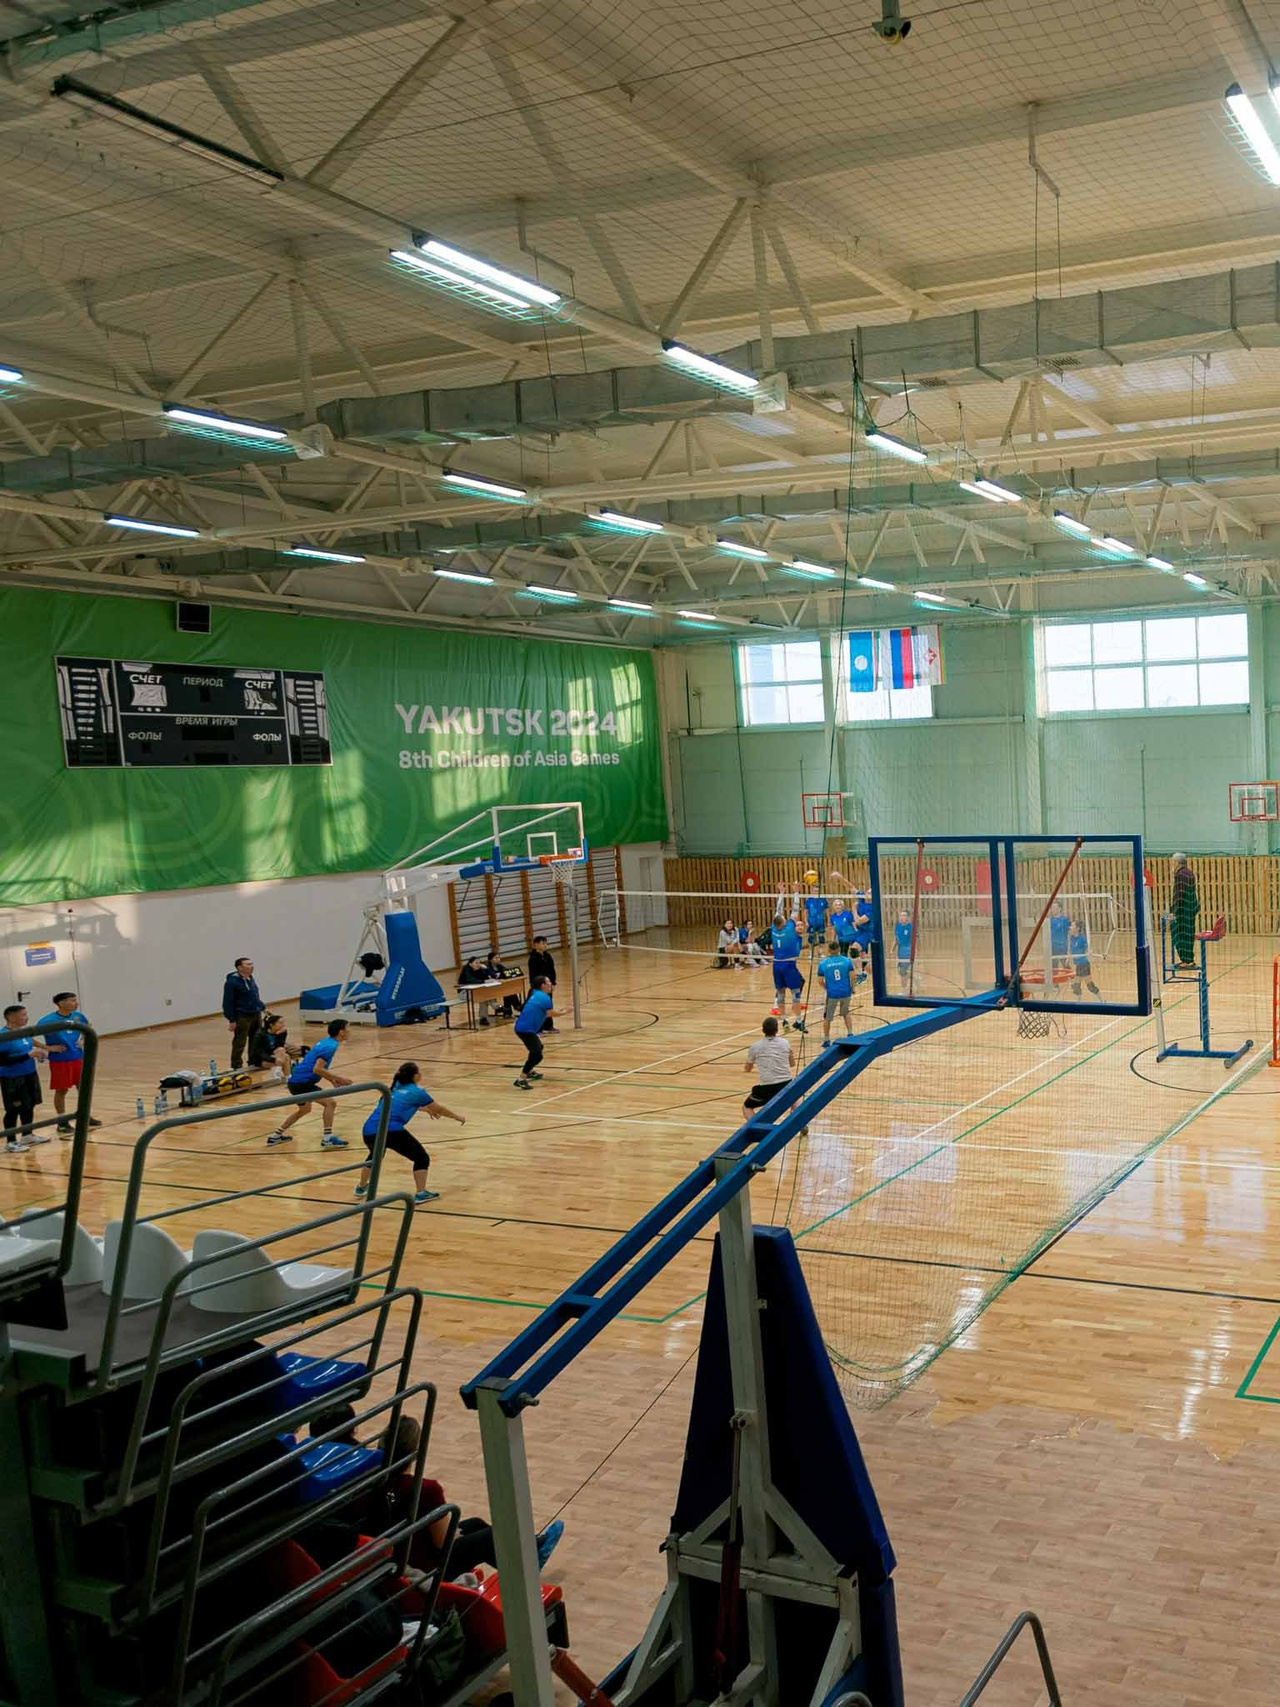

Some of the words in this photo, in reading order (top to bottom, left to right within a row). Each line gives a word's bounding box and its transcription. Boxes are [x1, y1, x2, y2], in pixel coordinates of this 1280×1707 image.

[130, 674, 163, 684] СЧЕТ
[183, 677, 223, 687] ПЕРИОД
[245, 680, 273, 689] СЧЕТ
[175, 716, 208, 725] ВРЕМЯ
[212, 717, 238, 726] ИГРЫ
[394, 703, 544, 735] YAKUTSK
[551, 709, 617, 736] 2024
[128, 731, 162, 741] ФОЛЫ
[252, 732, 281, 741] ФОЛЫ
[399, 751, 433, 768] 8th
[437, 750, 510, 768] Children
[513, 751, 532, 766] of
[534, 751, 566, 766] Asia
[571, 751, 620, 766] Games
